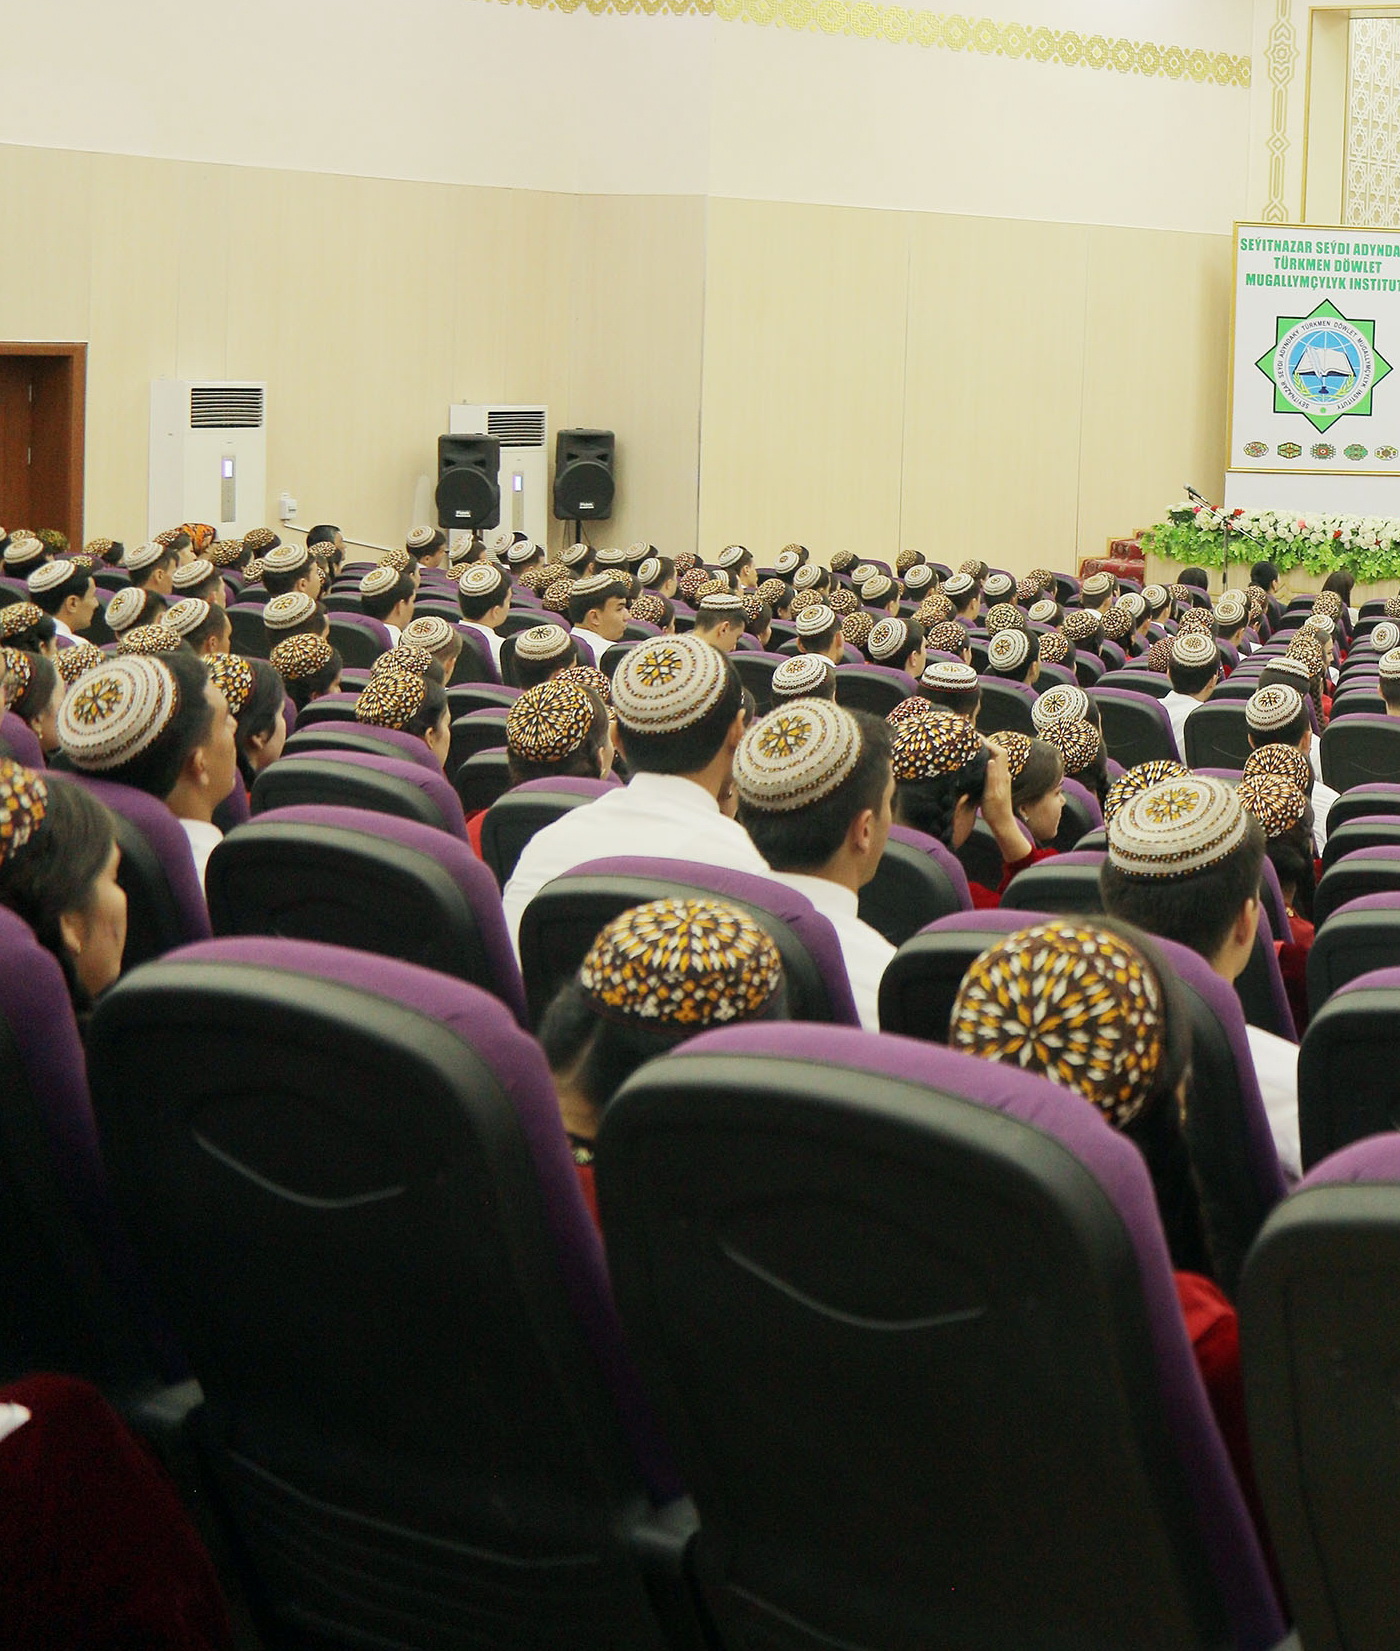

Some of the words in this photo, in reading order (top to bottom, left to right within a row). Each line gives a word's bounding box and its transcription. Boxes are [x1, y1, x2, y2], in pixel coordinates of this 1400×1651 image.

[1240, 236, 1312, 254] SEÝITNAZAR
[1315, 240, 1350, 255] SEÝDI
[1273, 255, 1331, 272] TÜRKMEN
[1334, 258, 1382, 274] DÖWLET
[1245, 273, 1346, 291] MUGALLYMÇYLYK
